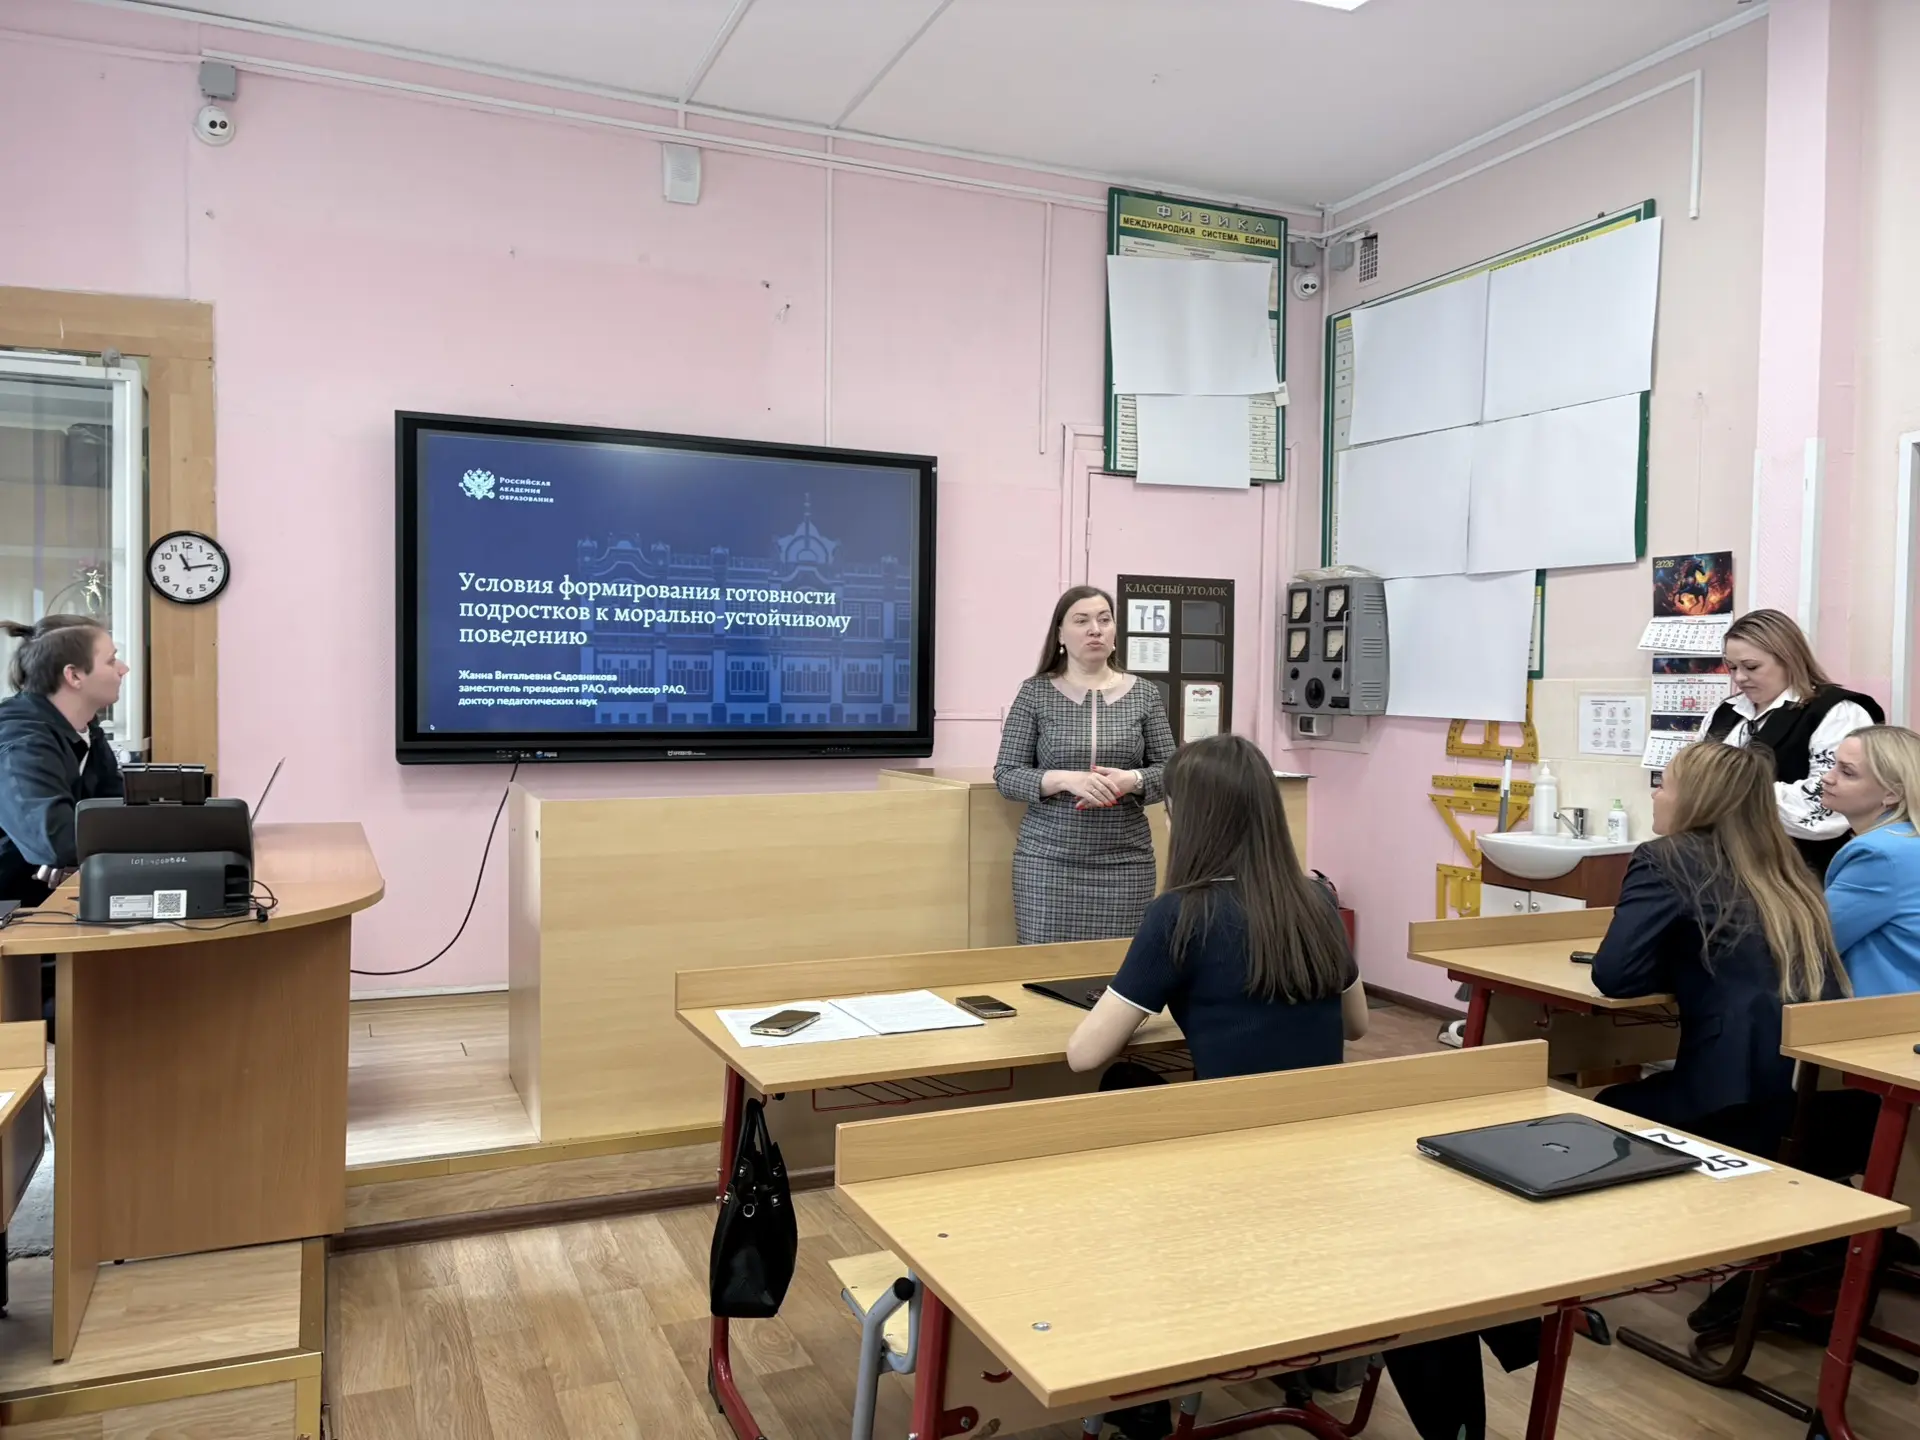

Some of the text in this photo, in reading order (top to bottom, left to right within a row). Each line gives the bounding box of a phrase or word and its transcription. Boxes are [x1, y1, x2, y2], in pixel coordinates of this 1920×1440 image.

[1156, 204, 1266, 234] ФИЗИКА
[1122, 217, 1278, 248] МЕЖДУНАРОДНАЯ СИСТЕМА ЕДИНИЦ
[158, 564, 166, 572] 9
[211, 564, 218, 572] 3
[1655, 560, 1675, 568] 2026
[172, 584, 180, 592] 7
[459, 572, 836, 605] Условия формирования готовности
[1125, 583, 1228, 596] КЛАССНЫЙ УГОЛОК
[459, 602, 851, 633] подростков к морально-устойчивому
[1135, 605, 1165, 631] 7-Б
[459, 628, 588, 646] поведению
[458, 670, 617, 682] Жанна Витальевна Садовникова
[458, 685, 687, 695] заместитель президента РАО, профессор РАО,
[458, 697, 598, 707] доктор педагогических наук
